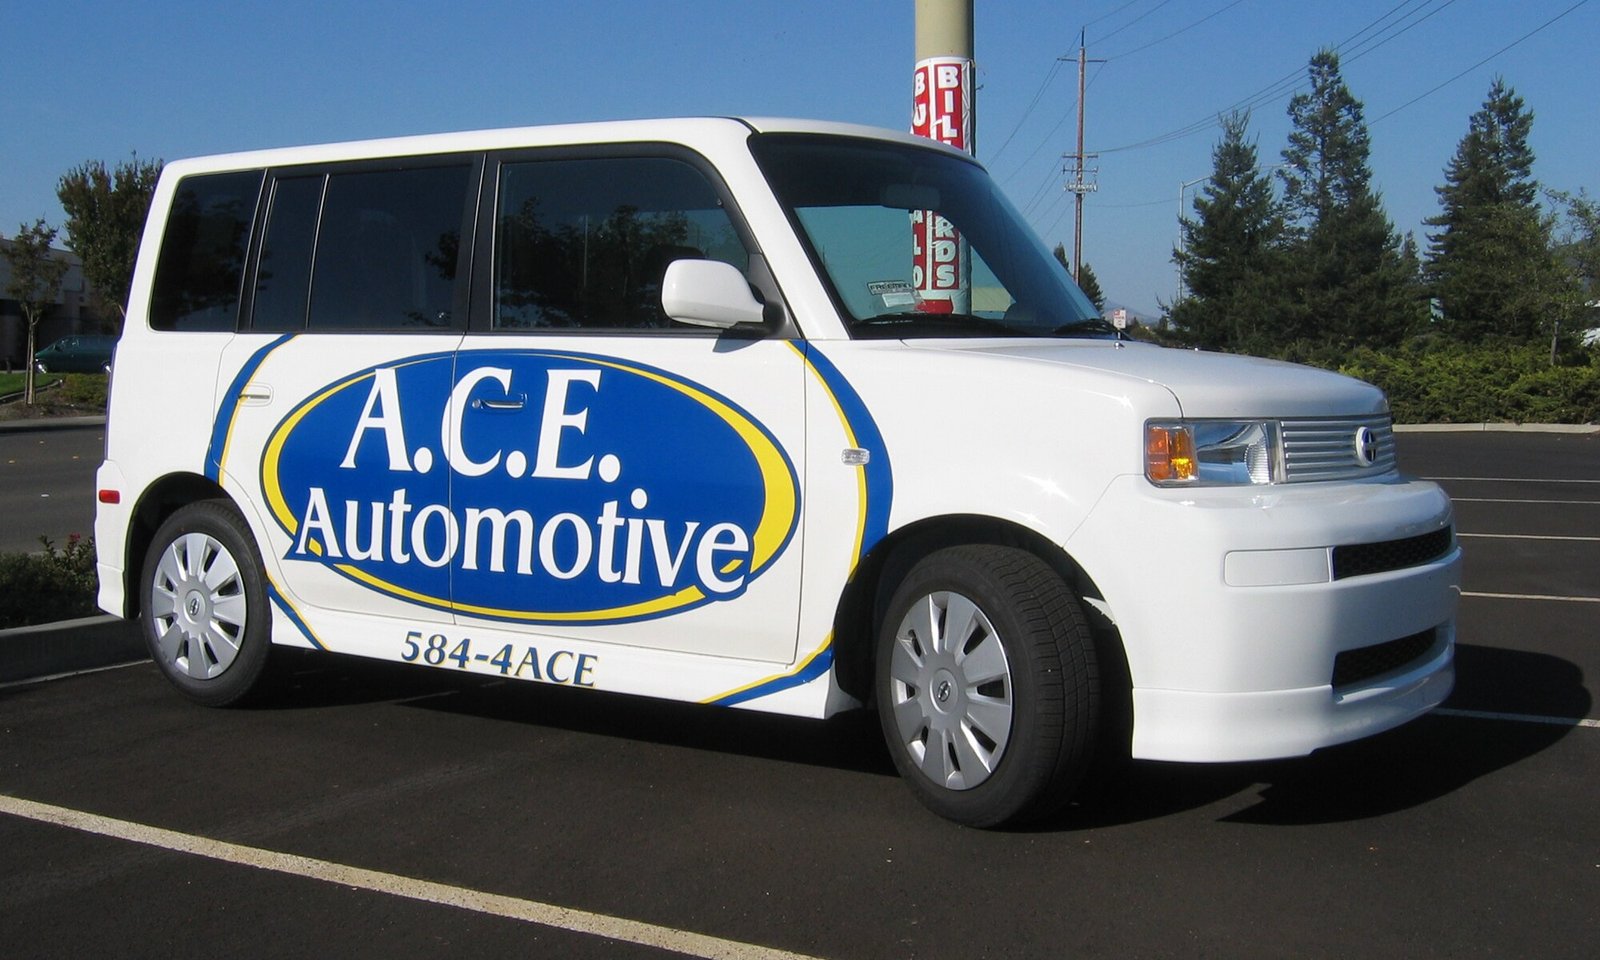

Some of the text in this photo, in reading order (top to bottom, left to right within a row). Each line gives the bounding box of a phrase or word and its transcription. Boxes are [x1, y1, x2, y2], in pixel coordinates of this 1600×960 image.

[340, 367, 620, 482] A.C.E.
[296, 487, 749, 593] Automotive
[401, 631, 598, 687] 584-4ACE
